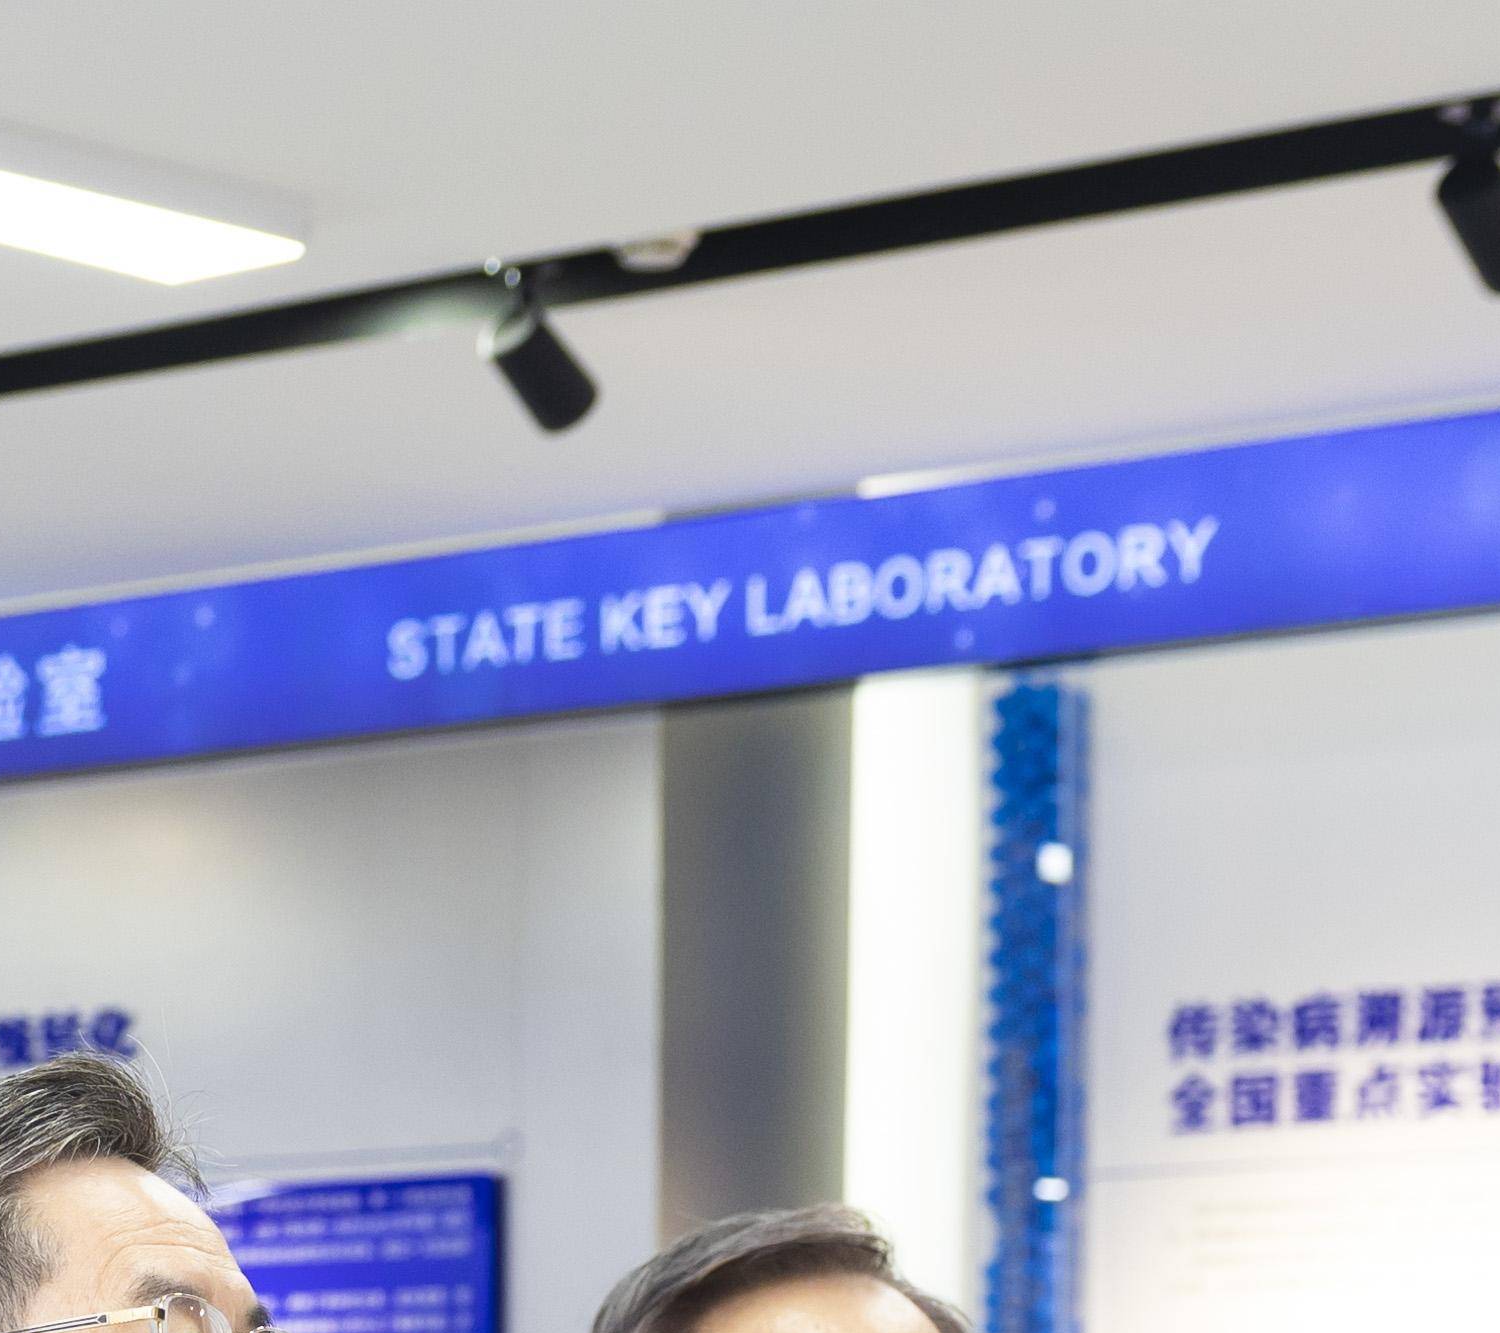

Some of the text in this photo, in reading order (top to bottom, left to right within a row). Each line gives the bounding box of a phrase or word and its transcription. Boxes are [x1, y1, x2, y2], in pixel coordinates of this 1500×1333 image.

[386, 516, 1221, 681] STATE KEY LABORATORY
